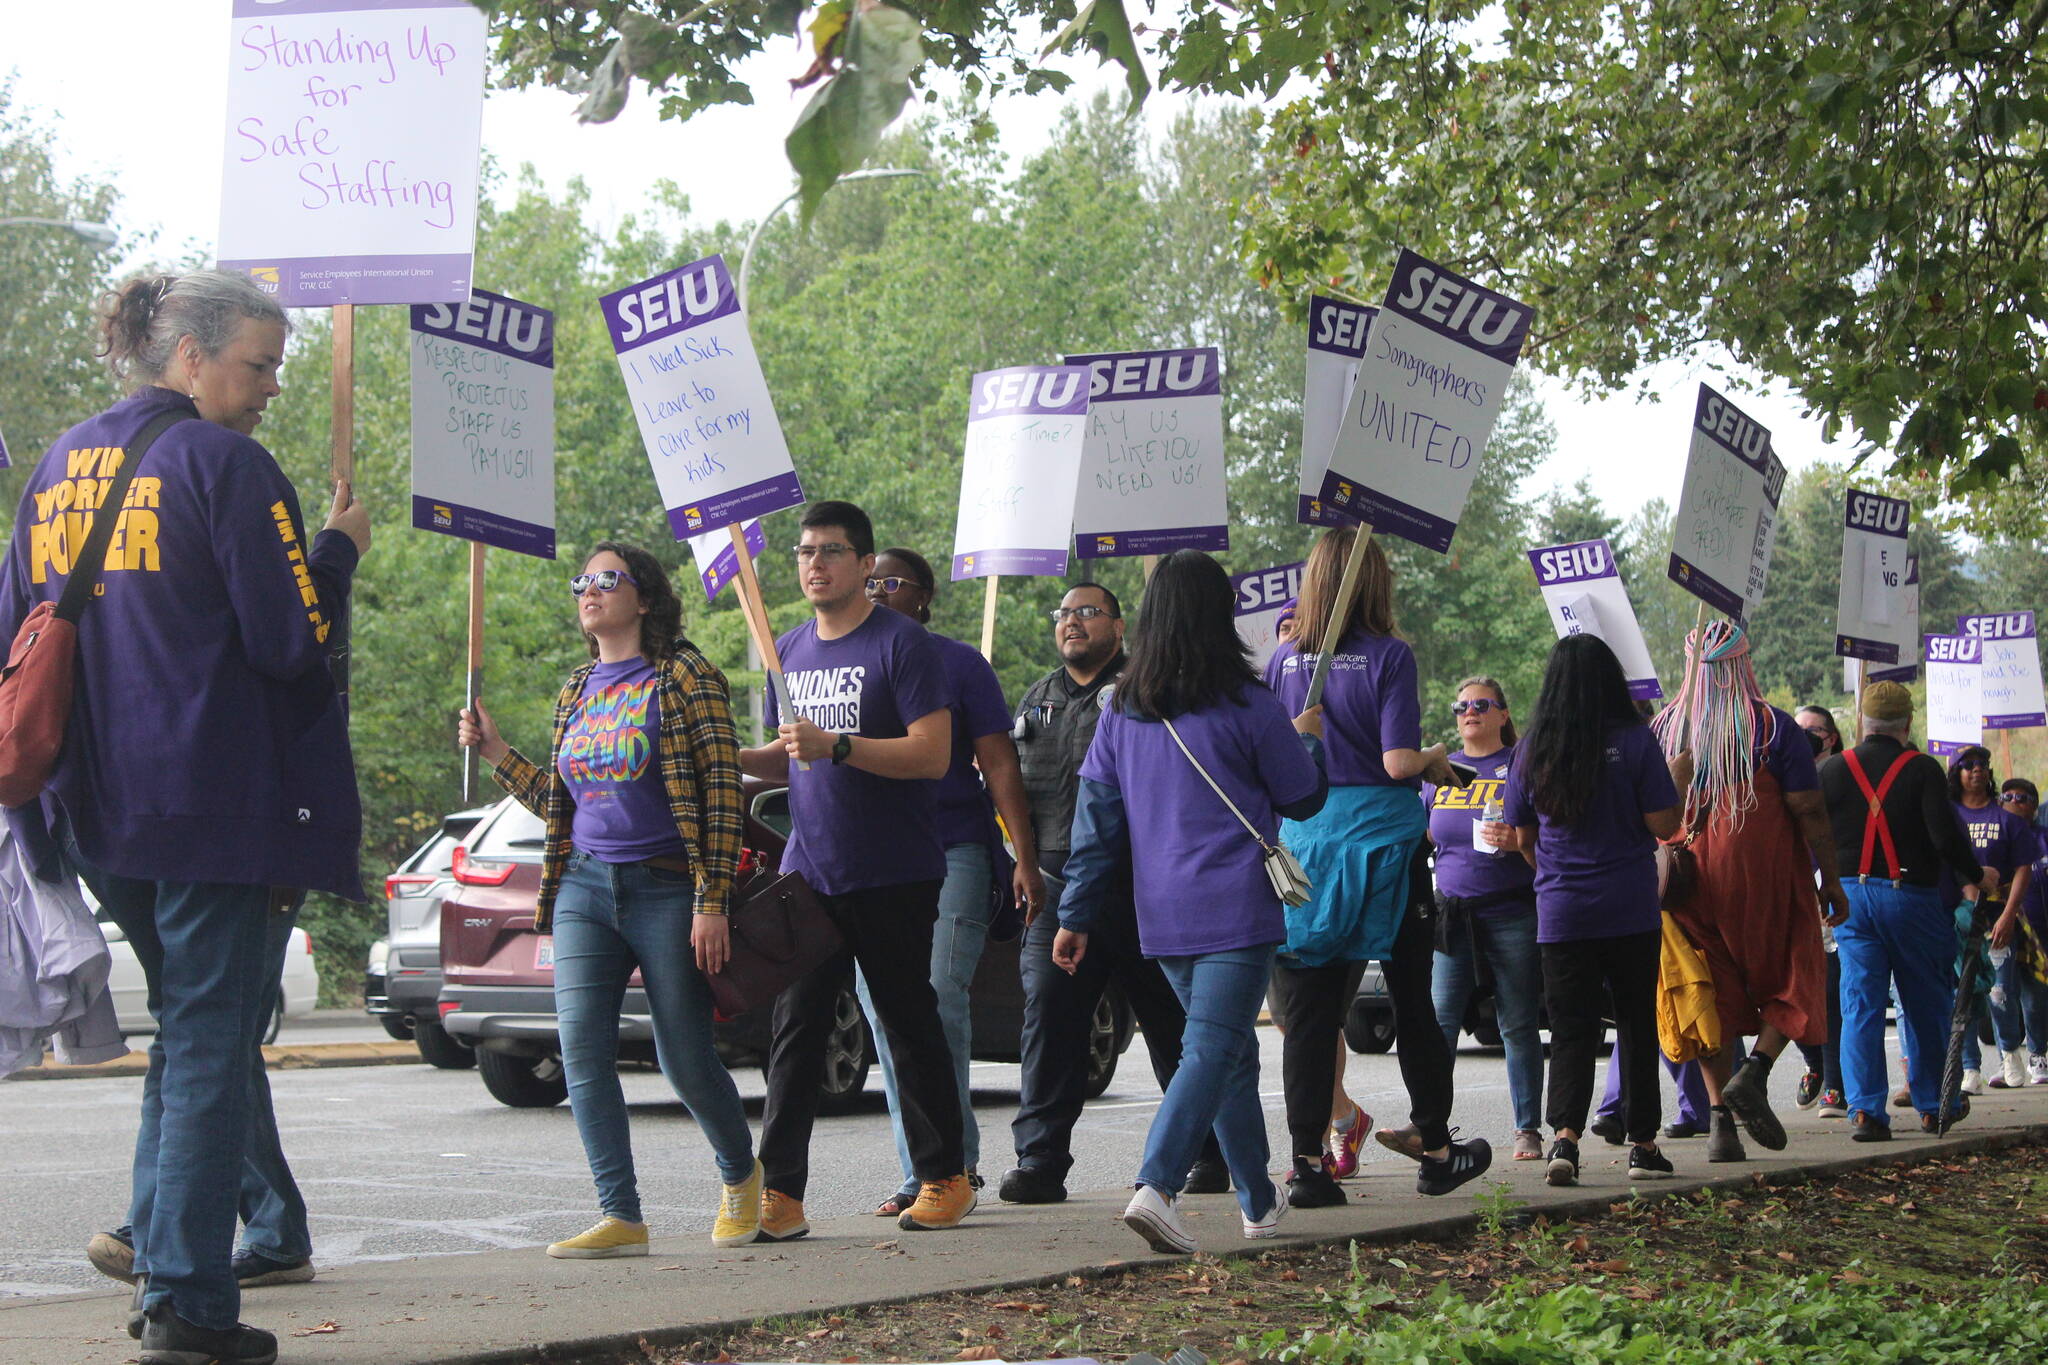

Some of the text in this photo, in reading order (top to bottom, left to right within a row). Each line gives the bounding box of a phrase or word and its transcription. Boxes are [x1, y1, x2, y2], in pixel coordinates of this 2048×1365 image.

[241, 25, 456, 84] Standing Up
[303, 75, 362, 108] for
[237, 115, 340, 163] Safe
[299, 159, 455, 229] Staffing
[300, 269, 324, 281] Service
[363, 266, 409, 278] International
[410, 266, 434, 277] Union
[424, 296, 544, 353] SEIU
[617, 264, 720, 343] SEIU
[1396, 266, 1522, 346] SEIU
[1316, 305, 1376, 351] SEI
[416, 332, 489, 374] RESPECT
[648, 345, 688, 375] Need
[684, 336, 734, 363] Sick
[442, 371, 529, 412] PROTECT US
[977, 372, 1081, 416] SEIU
[1089, 354, 1208, 398] SEIU
[445, 406, 522, 440] STAFF US
[642, 378, 716, 425] Leave to
[1150, 409, 1178, 434] US
[695, 415, 723, 442] for
[726, 407, 751, 436] my
[1359, 389, 1472, 470] UNITED
[1701, 396, 1767, 461] SEIU
[462, 432, 499, 481] PAY
[1106, 436, 1200, 469] LIKE YOU
[1096, 468, 1153, 497] NEED
[1764, 455, 1785, 501] EIU
[270, 500, 297, 543] WIN
[1850, 495, 1905, 532] SEIU
[287, 543, 319, 607] THE
[1540, 545, 1606, 582] SEIU
[1240, 568, 1304, 610] SEI
[1965, 614, 2027, 638] SEIU
[1929, 637, 1977, 660] SEIU
